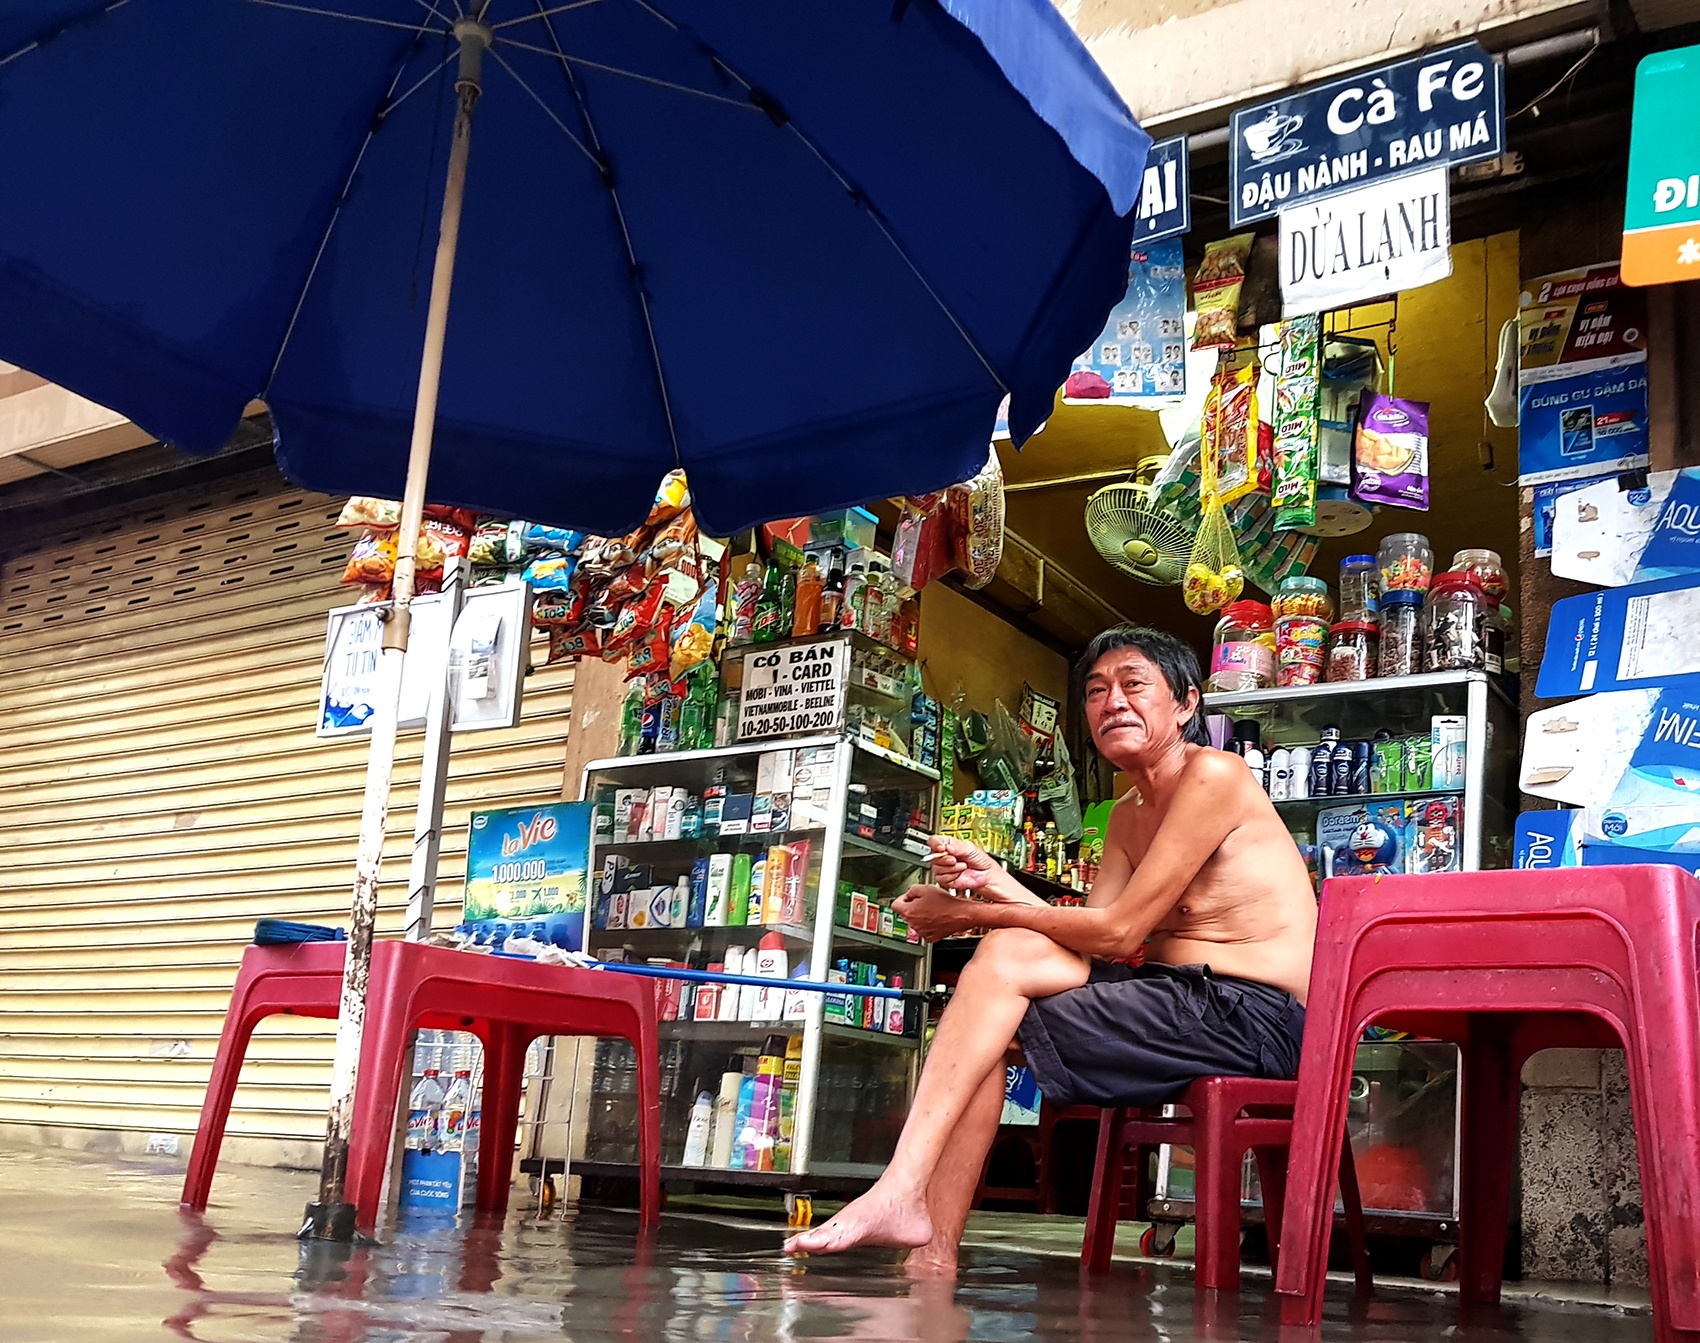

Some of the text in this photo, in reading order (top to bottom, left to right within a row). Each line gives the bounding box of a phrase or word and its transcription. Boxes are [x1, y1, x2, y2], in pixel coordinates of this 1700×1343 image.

[1326, 60, 1484, 135] Cà Fe
[1242, 171, 1291, 211] ĐẬU
[1297, 152, 1368, 193] NÀNH
[1389, 128, 1442, 168] RAU
[1450, 110, 1490, 152] MÁ
[1136, 159, 1178, 231] ẠI
[1290, 192, 1441, 286] DỪA LẠNH
[1538, 281, 1552, 303] 2
[1281, 421, 1303, 434] MILO
[1278, 481, 1299, 494] MILO
[753, 646, 834, 668] CÓ BÁN
[792, 662, 832, 681] CARD
[745, 687, 767, 702] MOBI
[773, 684, 793, 698] VINA
[800, 679, 836, 694] VIETTEL
[804, 695, 835, 710] BEELINE
